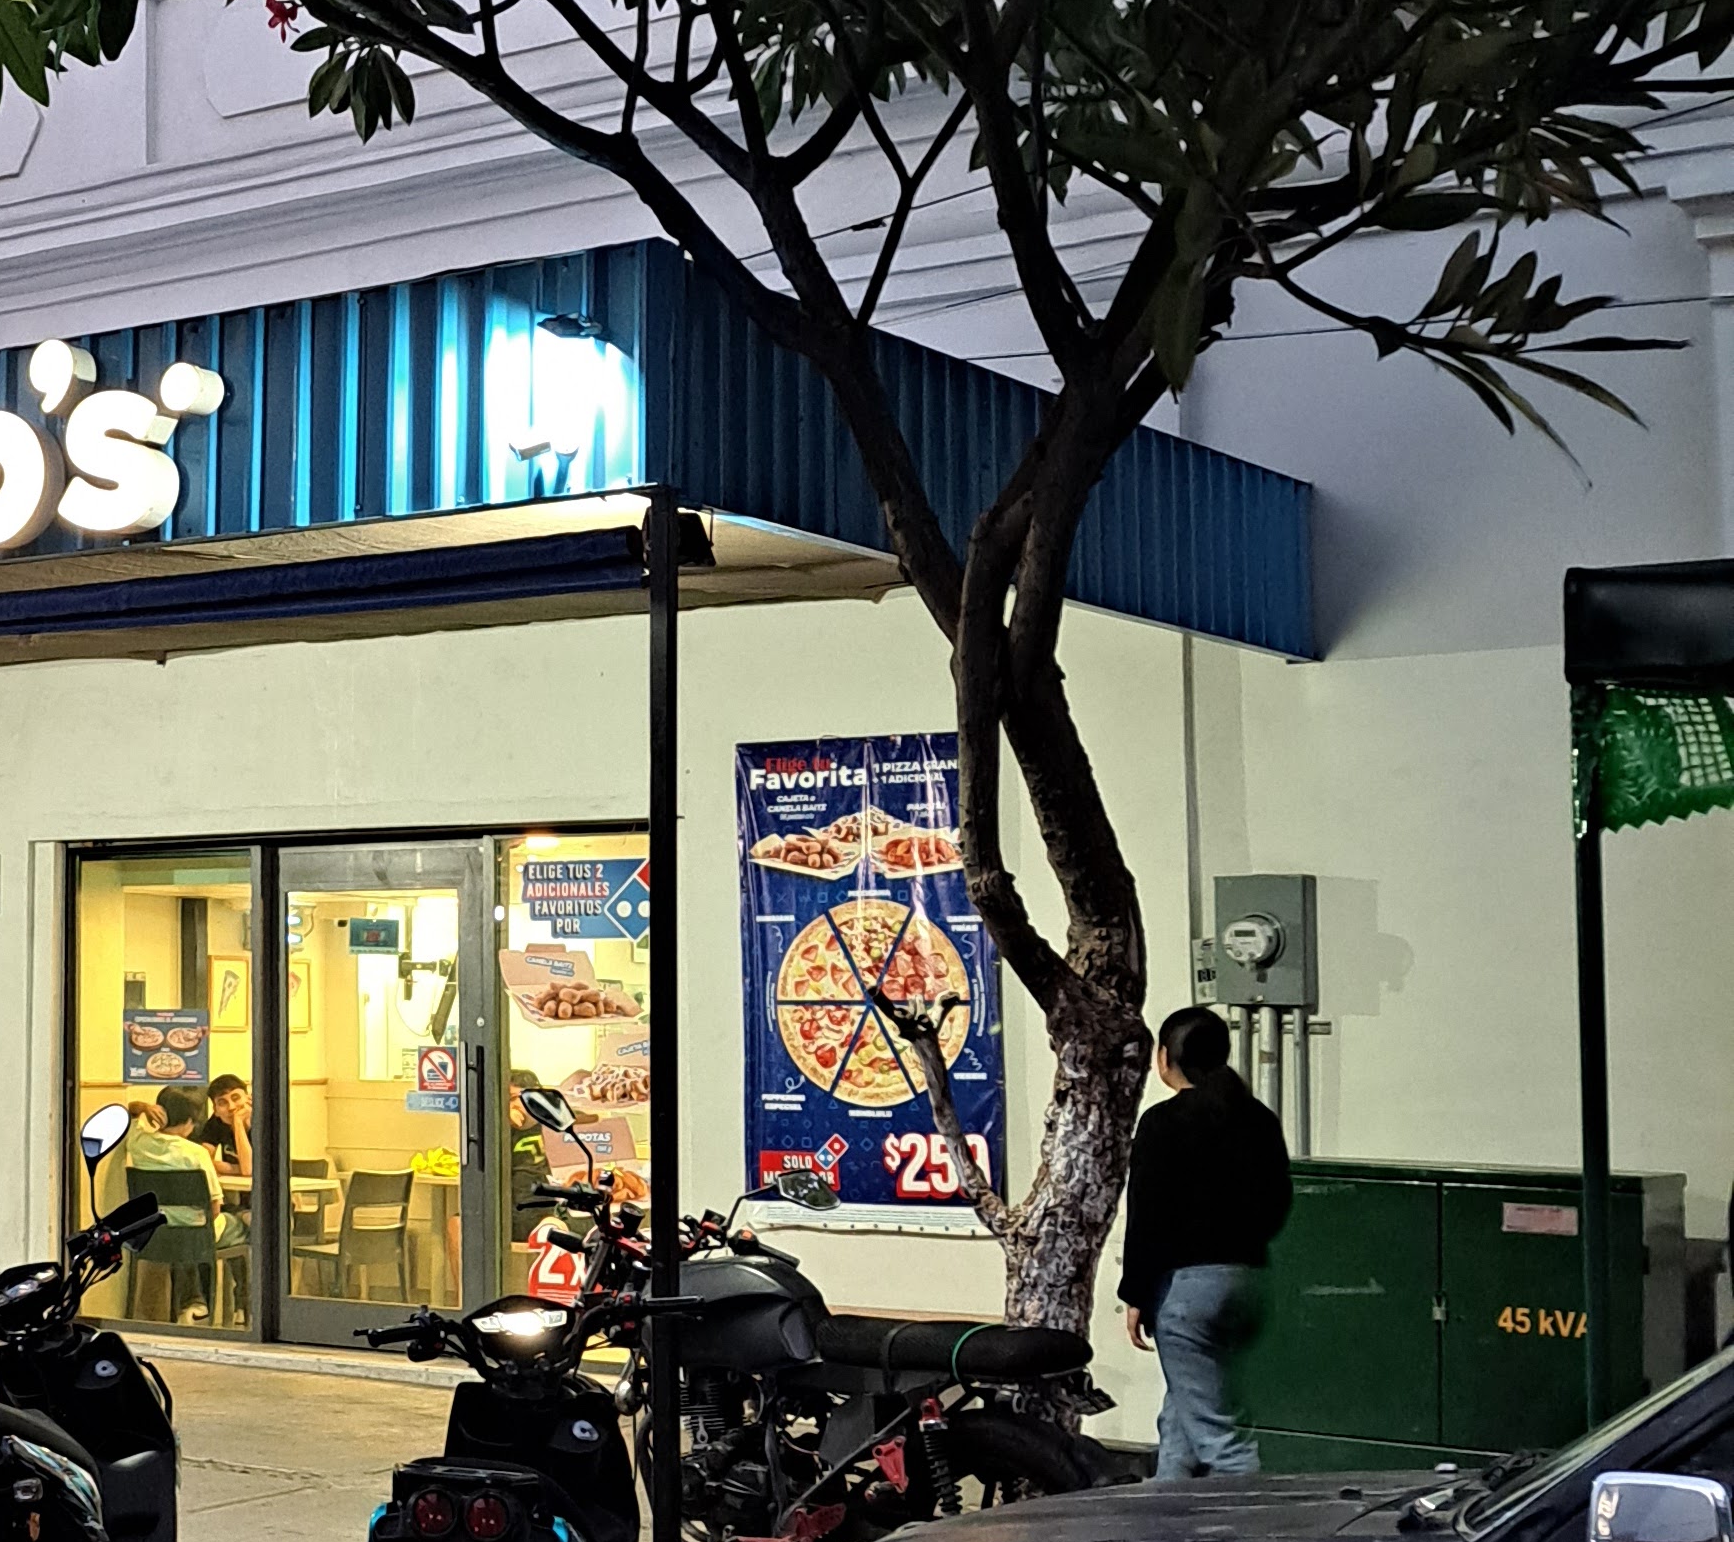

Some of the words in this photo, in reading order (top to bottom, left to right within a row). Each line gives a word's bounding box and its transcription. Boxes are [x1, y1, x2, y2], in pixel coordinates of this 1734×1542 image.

[883, 762, 921, 773] PIZZA
[923, 760, 958, 772] GRAN
[750, 762, 866, 790] Favorita
[528, 864, 563, 879] ELIGE
[567, 864, 591, 878] TUS
[595, 863, 604, 878] 2
[526, 881, 610, 898] ADICIONALES
[534, 900, 602, 915] FAVORITOS
[556, 919, 581, 933] POR
[783, 1155, 813, 1169] SOLO
[1498, 1307, 1530, 1334] 45
